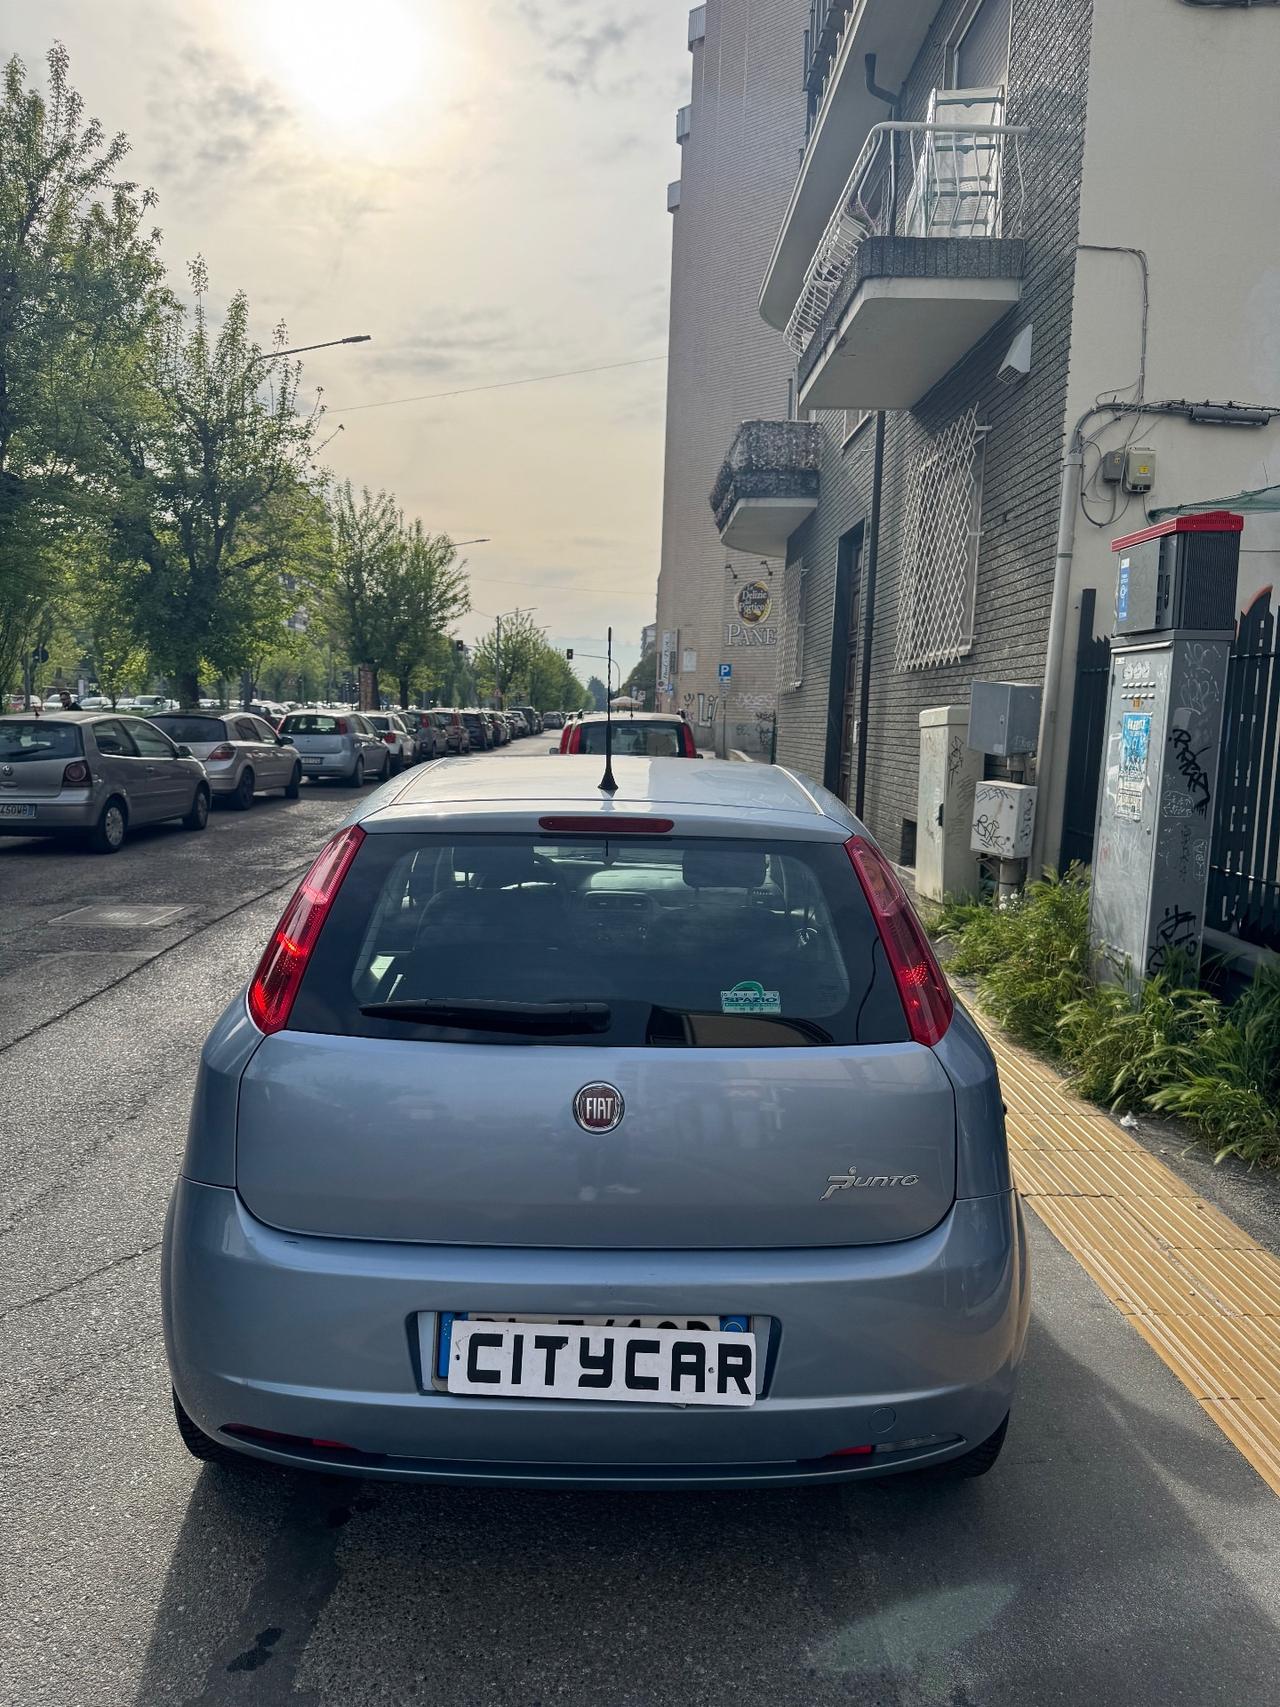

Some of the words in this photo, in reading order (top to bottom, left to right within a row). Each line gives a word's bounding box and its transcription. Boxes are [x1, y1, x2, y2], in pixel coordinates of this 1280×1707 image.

[742, 590, 767, 600] Delizie
[738, 602, 765, 612] Portico
[726, 623, 777, 646] PANE
[721, 666, 729, 675] P
[585, 1096, 614, 1120] FIAT
[466, 1331, 754, 1396] CITYCAR
